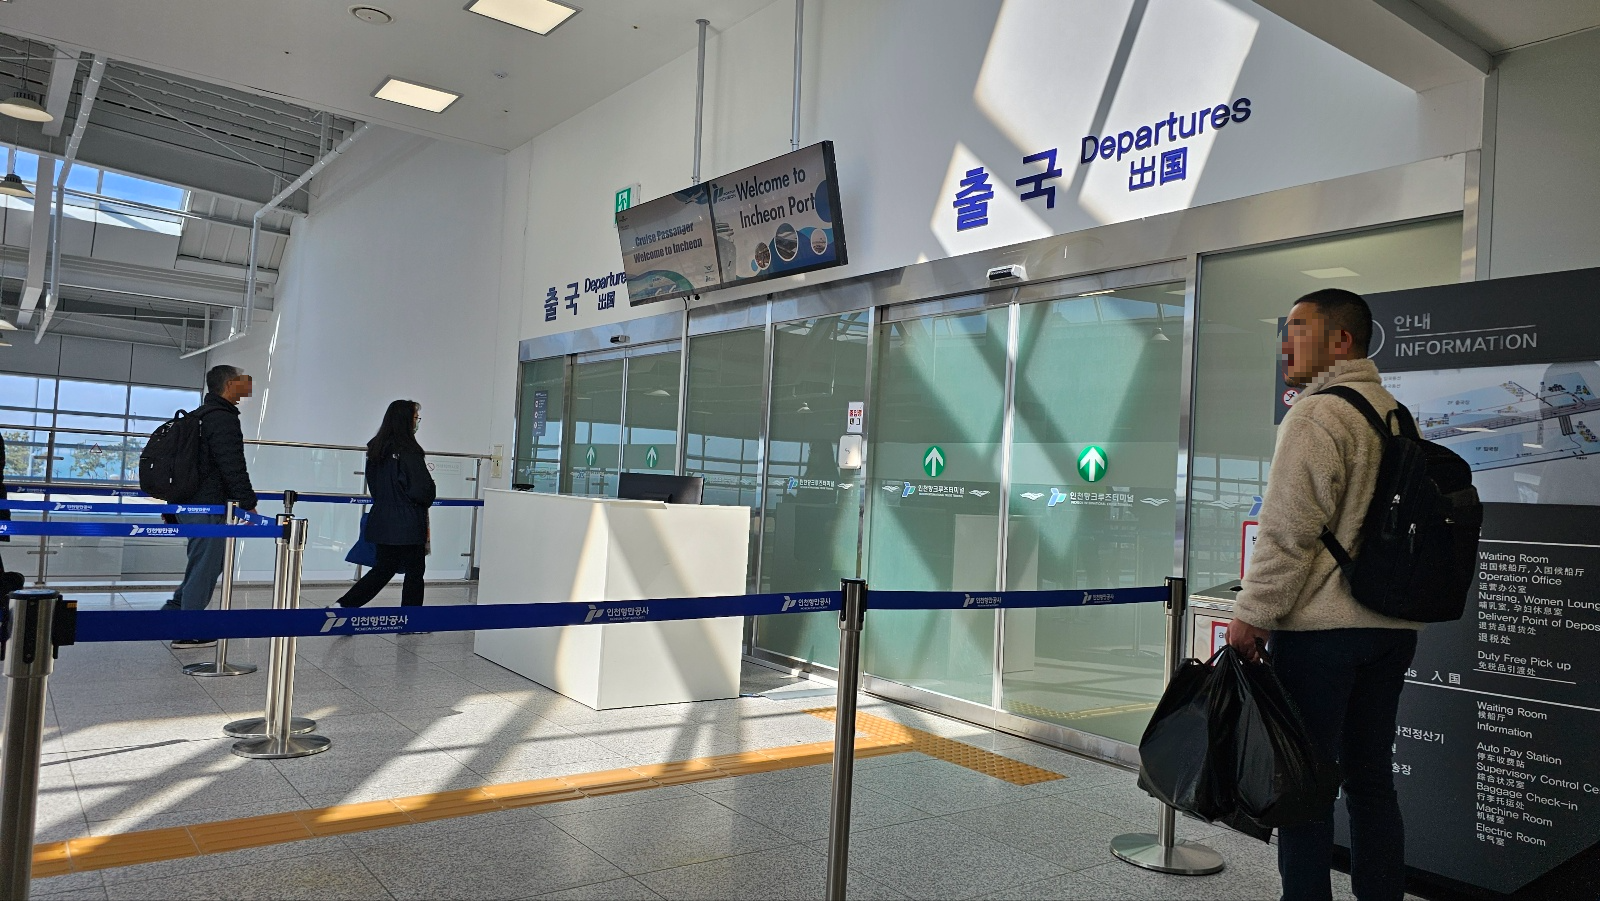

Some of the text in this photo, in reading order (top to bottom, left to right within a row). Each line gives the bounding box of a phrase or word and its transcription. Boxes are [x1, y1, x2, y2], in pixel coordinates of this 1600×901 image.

[1080, 97, 1252, 164] Departures
[1128, 146, 1188, 192] 出国
[735, 167, 806, 201] Welcome to
[740, 192, 815, 229] Incheon Port
[635, 232, 657, 247] Cruise
[633, 237, 703, 264] Welcome to Incheon
[597, 290, 616, 311] 出国
[1393, 312, 1431, 332] 안내
[1395, 332, 1537, 357] INFORMATION
[1070, 491, 1134, 503] 인천항크루즈터미널
[1478, 551, 1549, 564] Waiting Room
[1479, 571, 1562, 586] Operation Office
[1479, 582, 1527, 594] 运营办公室
[1523, 595, 1564, 607] Women
[606, 606, 650, 617] 인천항만공사
[1478, 611, 1519, 624] Delivery
[1522, 615, 1548, 626] Point
[1551, 619, 1562, 628] of
[351, 615, 409, 627] 인천항만공사
[1478, 632, 1511, 645] 退税处
[1477, 650, 1571, 671] Duty Free Pick up
[1478, 661, 1536, 677] 免税品引渡处
[1476, 701, 1548, 720] Waiting Room
[1477, 710, 1506, 723] 候船厅
[1476, 721, 1533, 739] Information
[1476, 741, 1562, 765] Auto Pay Station
[1477, 752, 1525, 769] 停车收费站
[1476, 761, 1537, 783] Supervisory
[1540, 774, 1579, 790] Control
[1476, 781, 1578, 811] Baggage Check-in
[1476, 792, 1525, 811] 行李托运处
[1476, 801, 1553, 827] Machine Room
[1476, 811, 1505, 825] 机械室
[1476, 822, 1546, 847] Electric Room
[1476, 832, 1505, 847] 电气室
